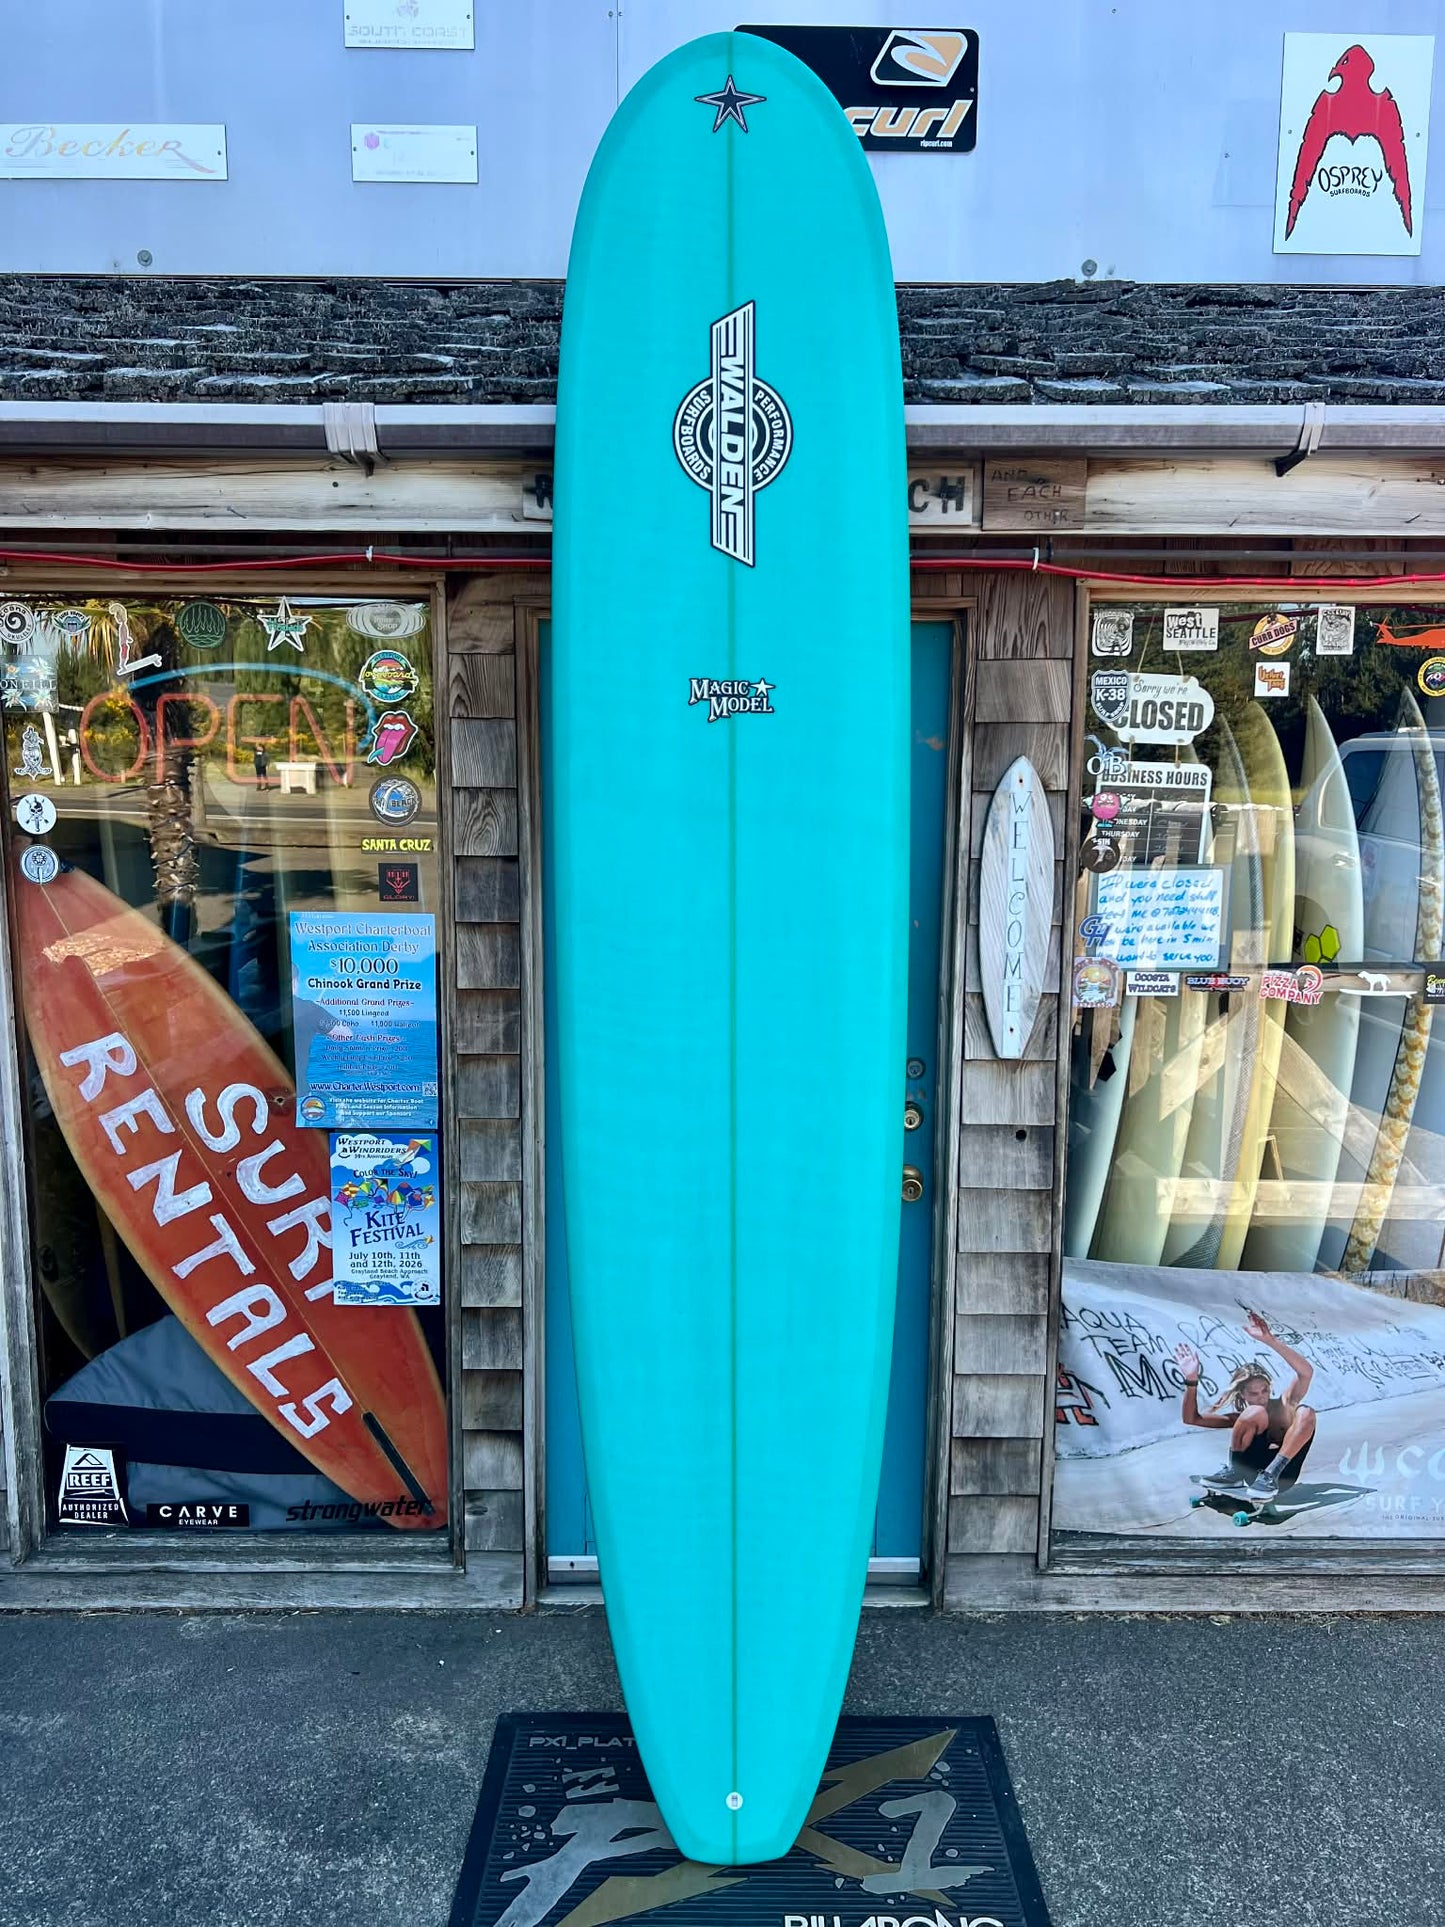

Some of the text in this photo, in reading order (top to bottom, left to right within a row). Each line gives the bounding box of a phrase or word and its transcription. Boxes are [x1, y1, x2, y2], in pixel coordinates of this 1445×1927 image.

[1318, 166, 1383, 193] OSPREY
[1330, 188, 1370, 197] SURFBOARDS
[680, 390, 713, 481] SURFBOARDS
[753, 389, 785, 481] PERFORMANCE
[1007, 485, 1062, 502] EACH
[1166, 628, 1217, 639] SEATTLE
[1251, 621, 1296, 646] CURB DOGS
[1096, 676, 1127, 686] MEXICO
[688, 678, 750, 705] MAGIC
[1096, 688, 1127, 701] K-38
[1133, 680, 1161, 698] Sorry
[708, 696, 774, 722] MODEL
[80, 691, 354, 788] OPEN
[1165, 770, 1208, 787] HOURS
[1101, 830, 1140, 838] THURSDAY
[362, 838, 431, 852] SANTA CRUZ
[1161, 876, 1214, 889] closed
[1003, 790, 1033, 1013] WELCOME
[1099, 891, 1126, 904] and
[1131, 894, 1152, 907] you
[1156, 889, 1186, 902] need
[295, 922, 432, 936] Westport Charterboat
[1146, 920, 1197, 932] available
[308, 940, 420, 954] Association Derby
[1121, 938, 1135, 946] be
[1182, 934, 1192, 944] 5
[331, 957, 399, 974] $10,000
[308, 978, 422, 990] Chinook Grand Prize
[1127, 983, 1176, 993] WILDCATS
[1186, 977, 1214, 986] BLUE
[1262, 976, 1299, 990] PIZZA
[361, 998, 385, 1006] Grand
[1260, 988, 1322, 1004] COMPANY
[349, 1146, 407, 1154] WINDRIDERS
[353, 1168, 418, 1179] COLOR THE SKY!
[365, 1209, 407, 1230] KITE
[60, 1032, 353, 1439] RENTALS
[350, 1222, 425, 1248] FESTIVAL
[349, 1251, 421, 1261] July 10th, 11th
[350, 1260, 423, 1268] and 12th, 2026
[1060, 1302, 1150, 1339] AQUA
[1080, 1325, 1176, 1358] TEAM
[68, 1473, 111, 1487] REEF
[62, 1503, 119, 1511] AUTHORIZED
[285, 1493, 429, 1522] strongwater
[1365, 1495, 1421, 1512] SURF
[74, 1511, 108, 1519] DEALER
[159, 1505, 238, 1518] CARVE
[178, 1518, 218, 1526] EYEWEAR
